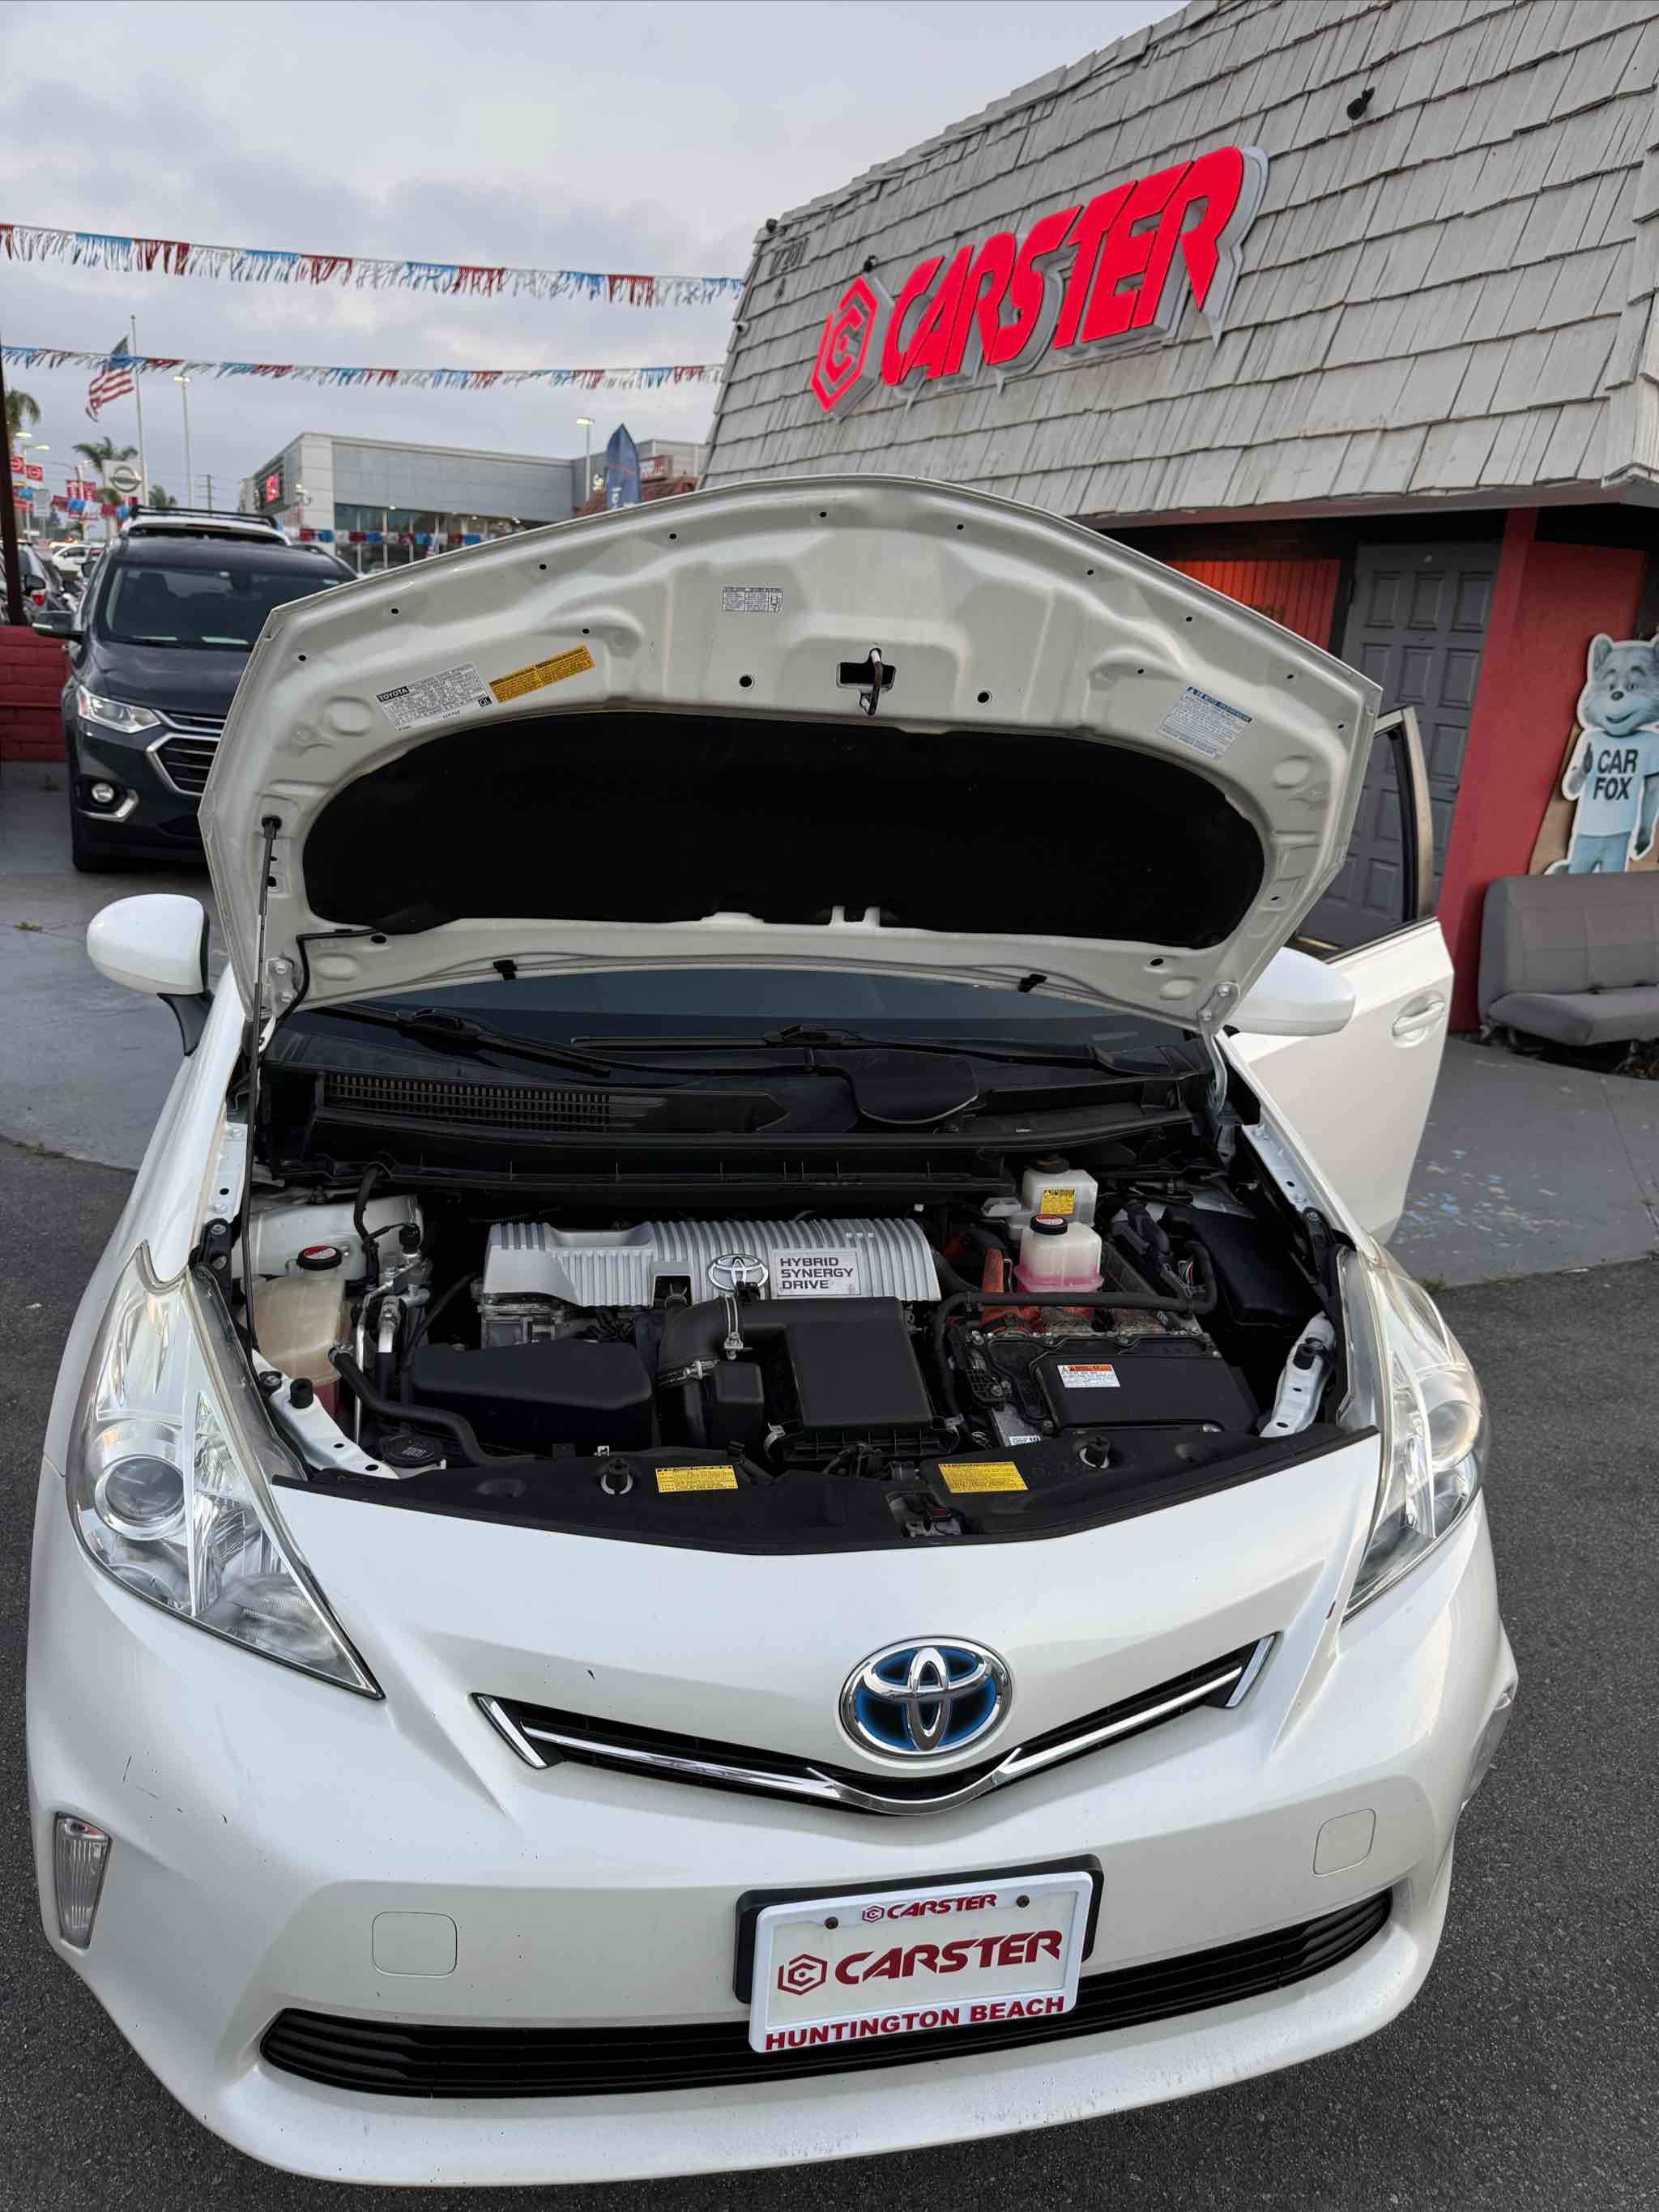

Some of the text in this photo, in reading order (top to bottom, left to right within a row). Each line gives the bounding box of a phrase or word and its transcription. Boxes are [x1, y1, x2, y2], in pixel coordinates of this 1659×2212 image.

[881, 146, 1244, 386] CARSTER
[378, 687, 408, 702] TOYOTA
[1597, 749, 1638, 774] CAR
[1593, 777, 1633, 800] FOX
[780, 1257, 838, 1266] HYBRID
[781, 1268, 853, 1278] SYNERGY
[782, 1280, 829, 1289] DRIVE
[887, 1894, 997, 1919] CARSTER
[834, 1930, 1063, 1985] CARSTER
[766, 1995, 1064, 2051] HUNTINGTON BEACH
